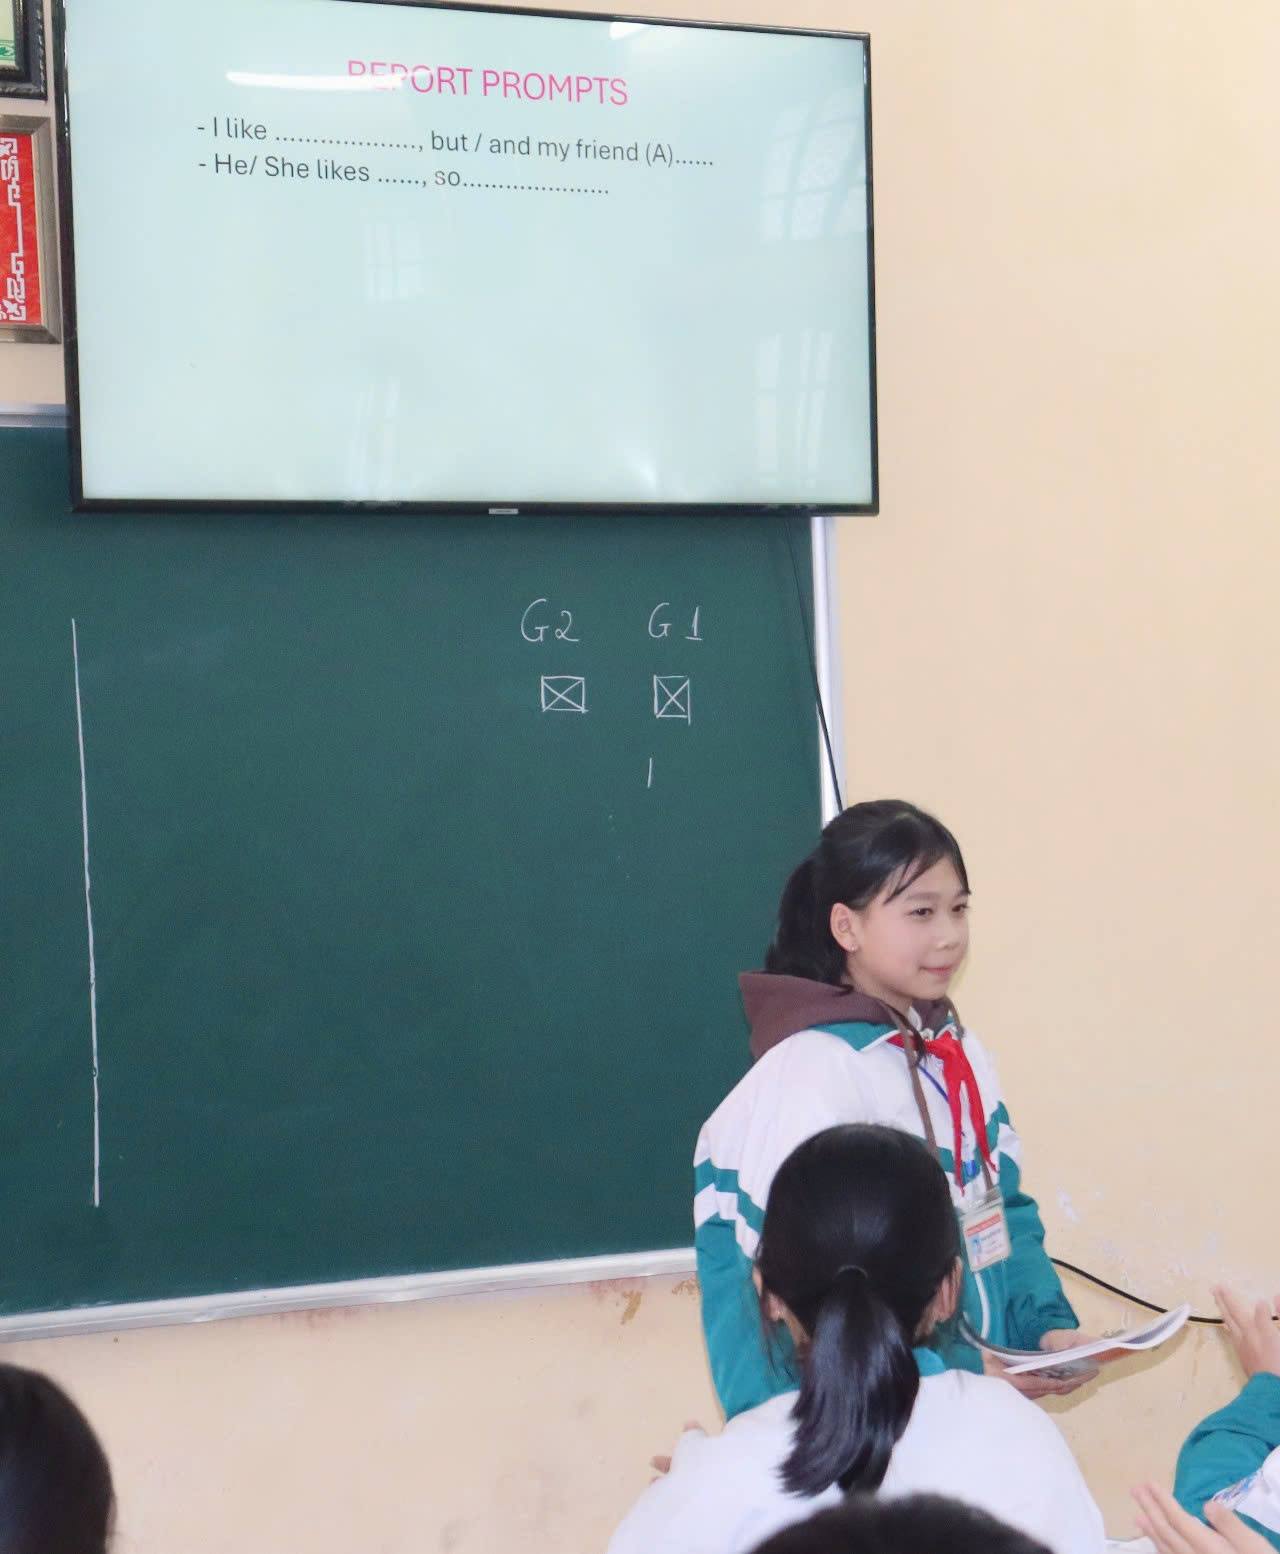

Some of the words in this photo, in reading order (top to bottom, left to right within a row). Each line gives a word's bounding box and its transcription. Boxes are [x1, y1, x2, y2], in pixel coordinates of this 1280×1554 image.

[481, 69, 628, 106] PROMPTS
[213, 116, 218, 138] I
[226, 117, 268, 140] like
[430, 130, 469, 152] but
[474, 132, 483, 153] /
[489, 135, 530, 156] and
[538, 140, 570, 162] my
[576, 139, 639, 162] friend
[214, 153, 258, 176] He/
[264, 155, 310, 179] She
[317, 158, 370, 182] likes
[520, 598, 580, 642] G2
